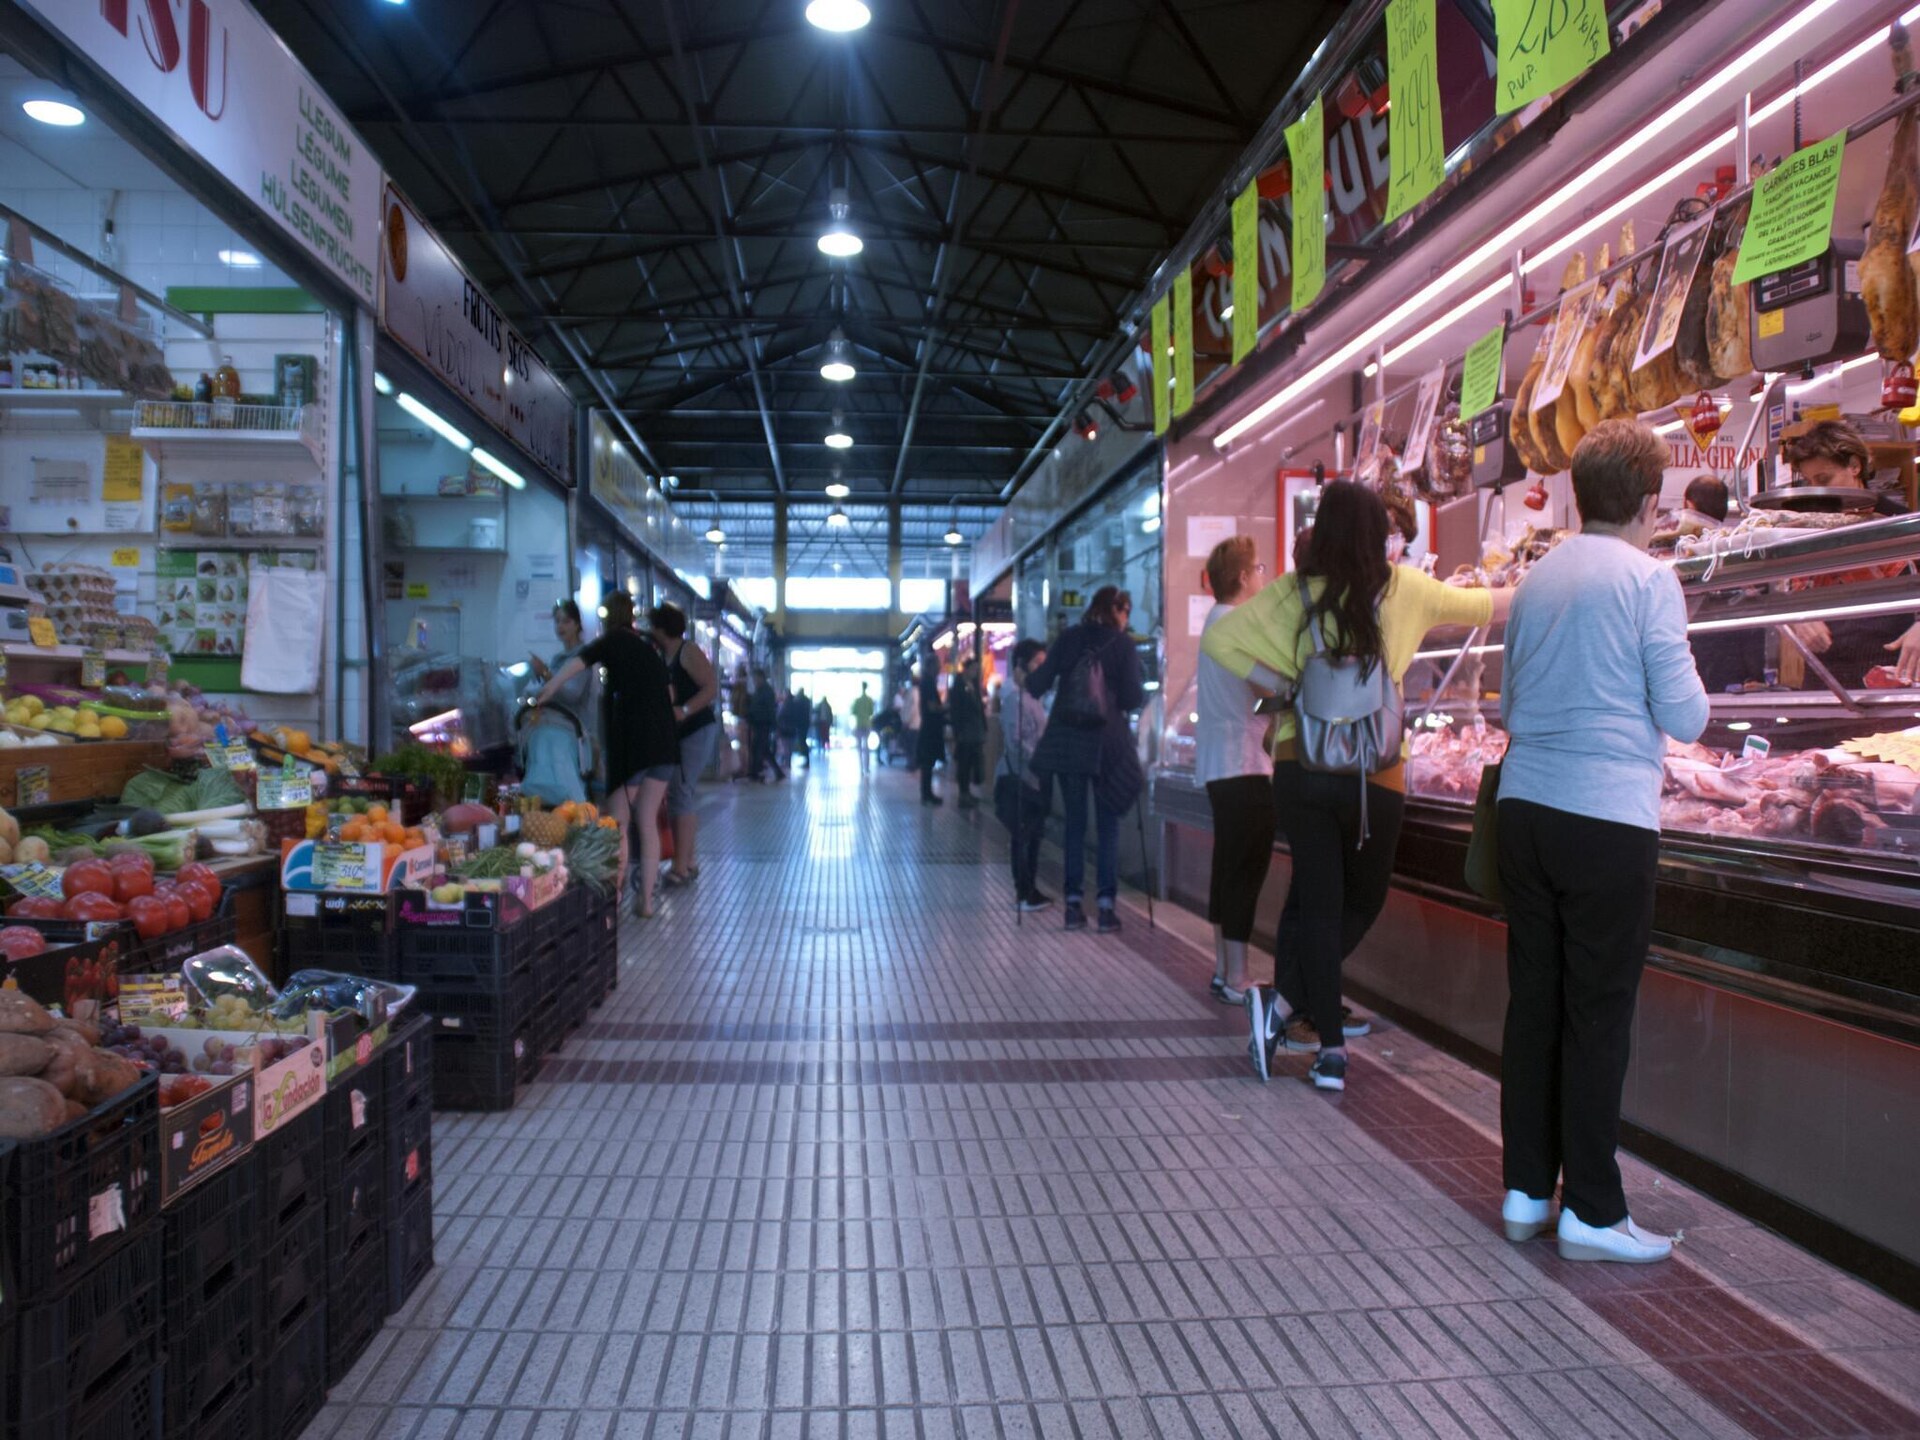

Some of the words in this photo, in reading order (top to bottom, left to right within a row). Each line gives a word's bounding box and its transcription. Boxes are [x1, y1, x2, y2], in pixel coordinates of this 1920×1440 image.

[296, 123, 350, 203] LÉGUME
[298, 86, 351, 166] LLEGUM
[261, 170, 373, 296] HÜLSENFRÜCHTE
[291, 158, 353, 243] LEGUMEN
[463, 277, 502, 353] FRUITS
[507, 330, 530, 383] SECS
